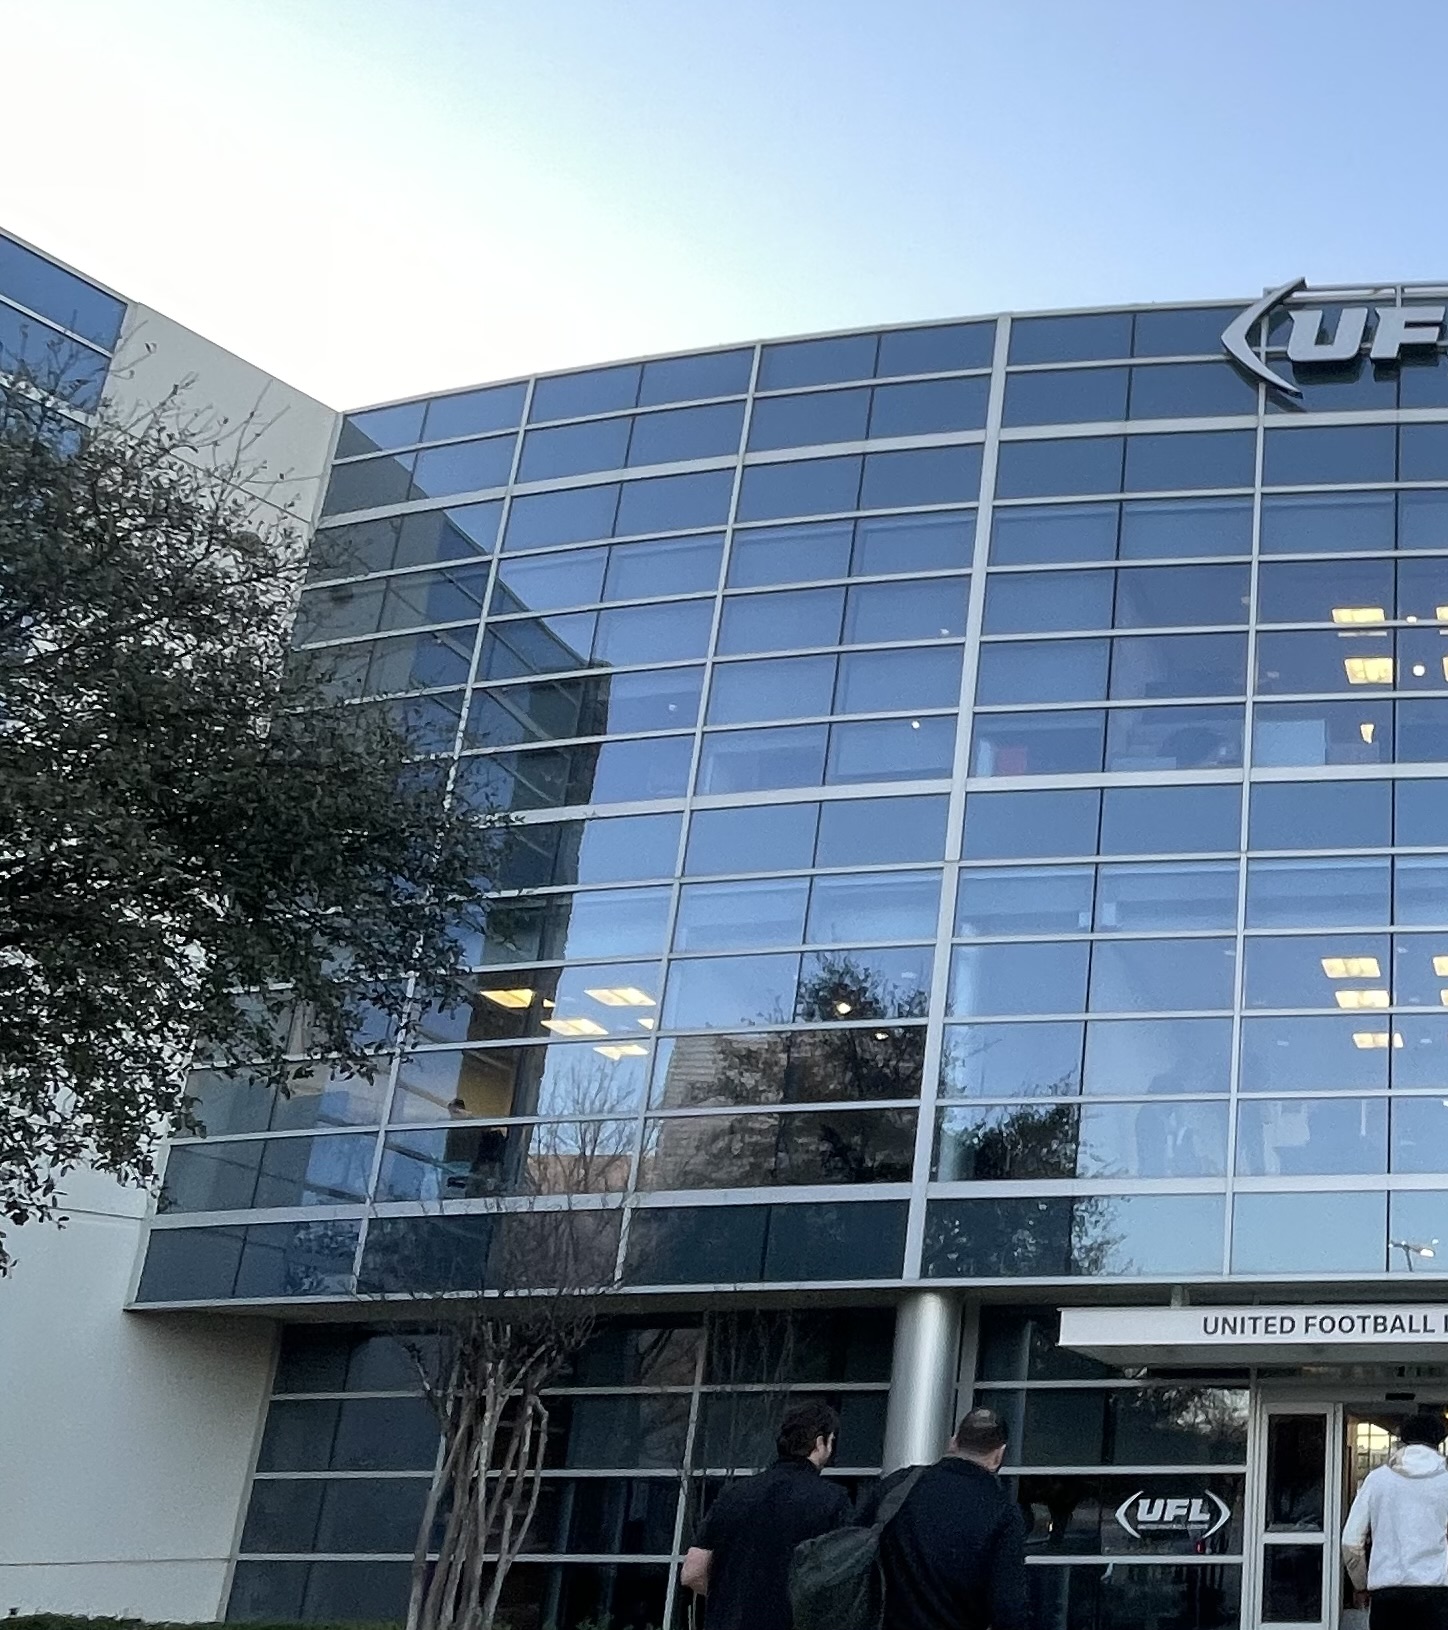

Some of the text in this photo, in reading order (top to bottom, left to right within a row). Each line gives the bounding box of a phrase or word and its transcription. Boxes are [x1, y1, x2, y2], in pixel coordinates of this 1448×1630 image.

[1203, 1315, 1296, 1335] UNITED
[1304, 1314, 1435, 1335] FOOTBALL
[1137, 1498, 1210, 1522] UFL
